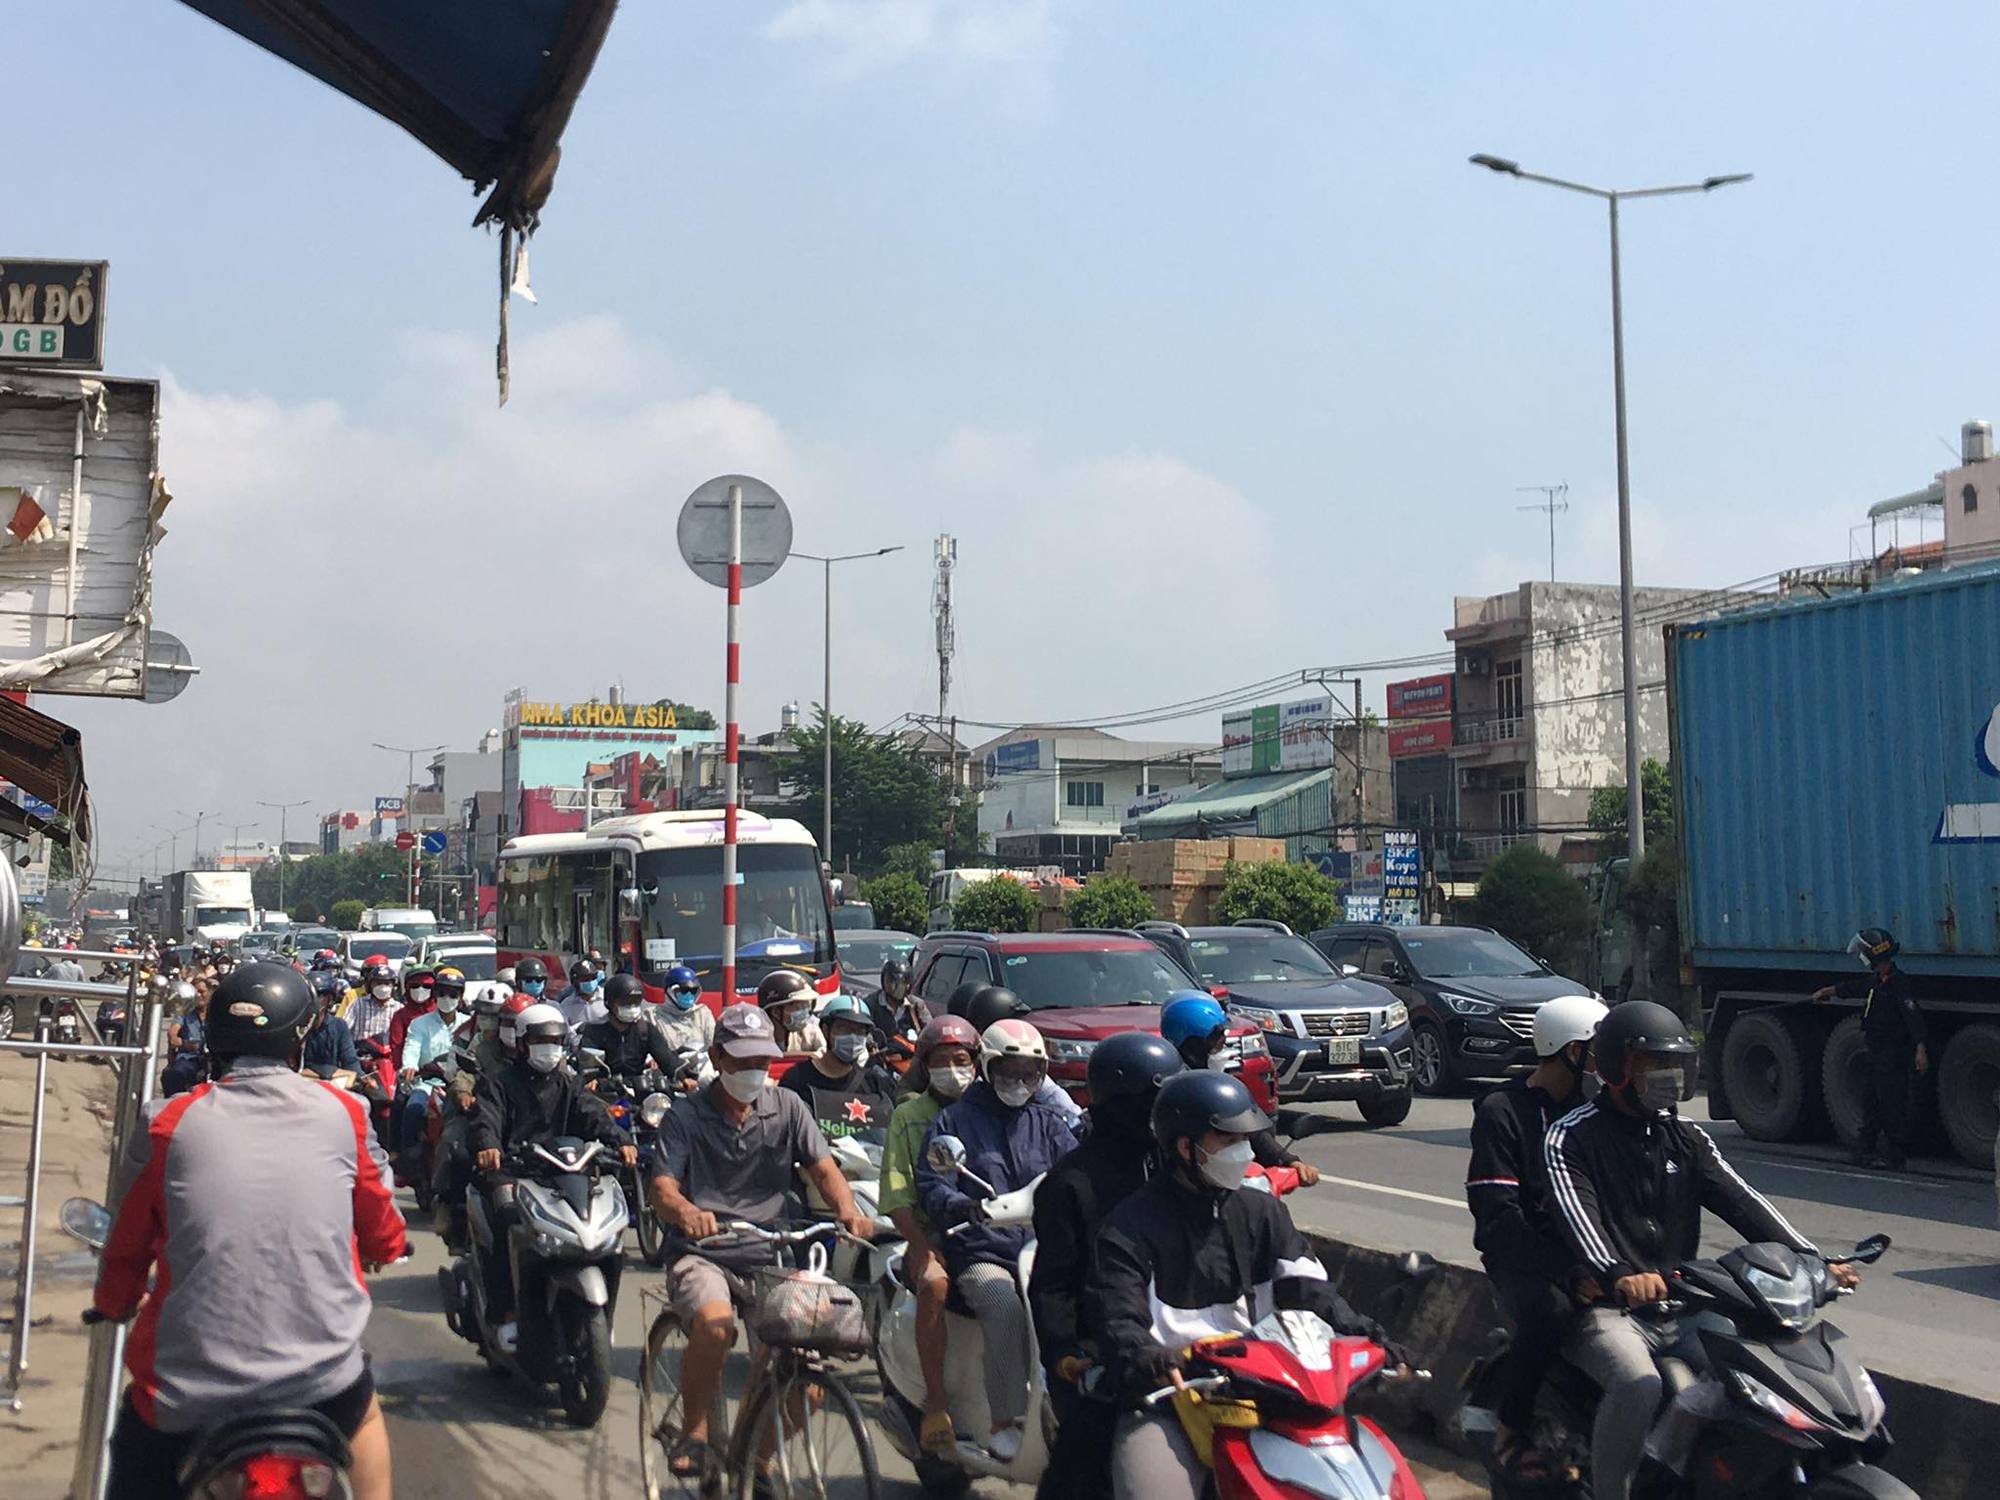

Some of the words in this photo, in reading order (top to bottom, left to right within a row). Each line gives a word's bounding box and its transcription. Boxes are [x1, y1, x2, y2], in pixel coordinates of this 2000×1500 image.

[0, 264, 37, 323] M
[0, 328, 57, 353] GB
[572, 703, 627, 726] KHOA
[633, 704, 677, 728] ASIA
[378, 800, 401, 809] ACB
[1386, 858, 1417, 874] Koyo
[819, 1118, 873, 1137] Hein
